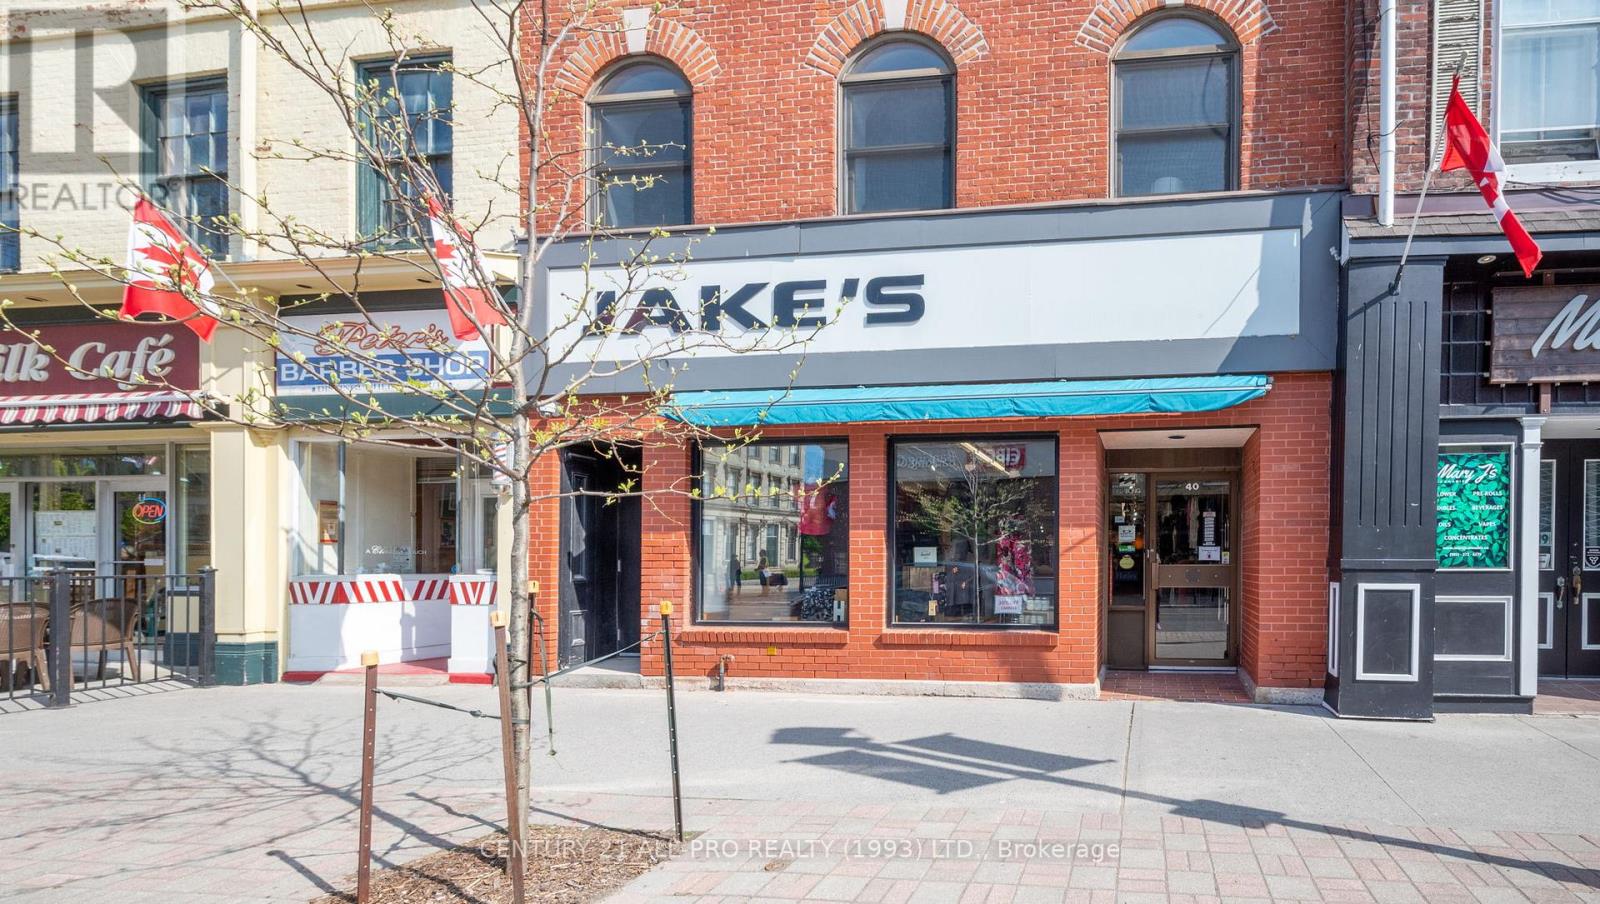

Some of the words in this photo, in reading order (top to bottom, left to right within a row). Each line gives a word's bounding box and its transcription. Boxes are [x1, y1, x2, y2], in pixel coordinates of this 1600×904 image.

[581, 274, 925, 338] JAKE'S
[68, 333, 175, 391] Café
[406, 354, 485, 377] SHOP
[1437, 463, 1475, 484] Mary
[1185, 482, 1199, 491] 40
[136, 504, 164, 518] OPEN
